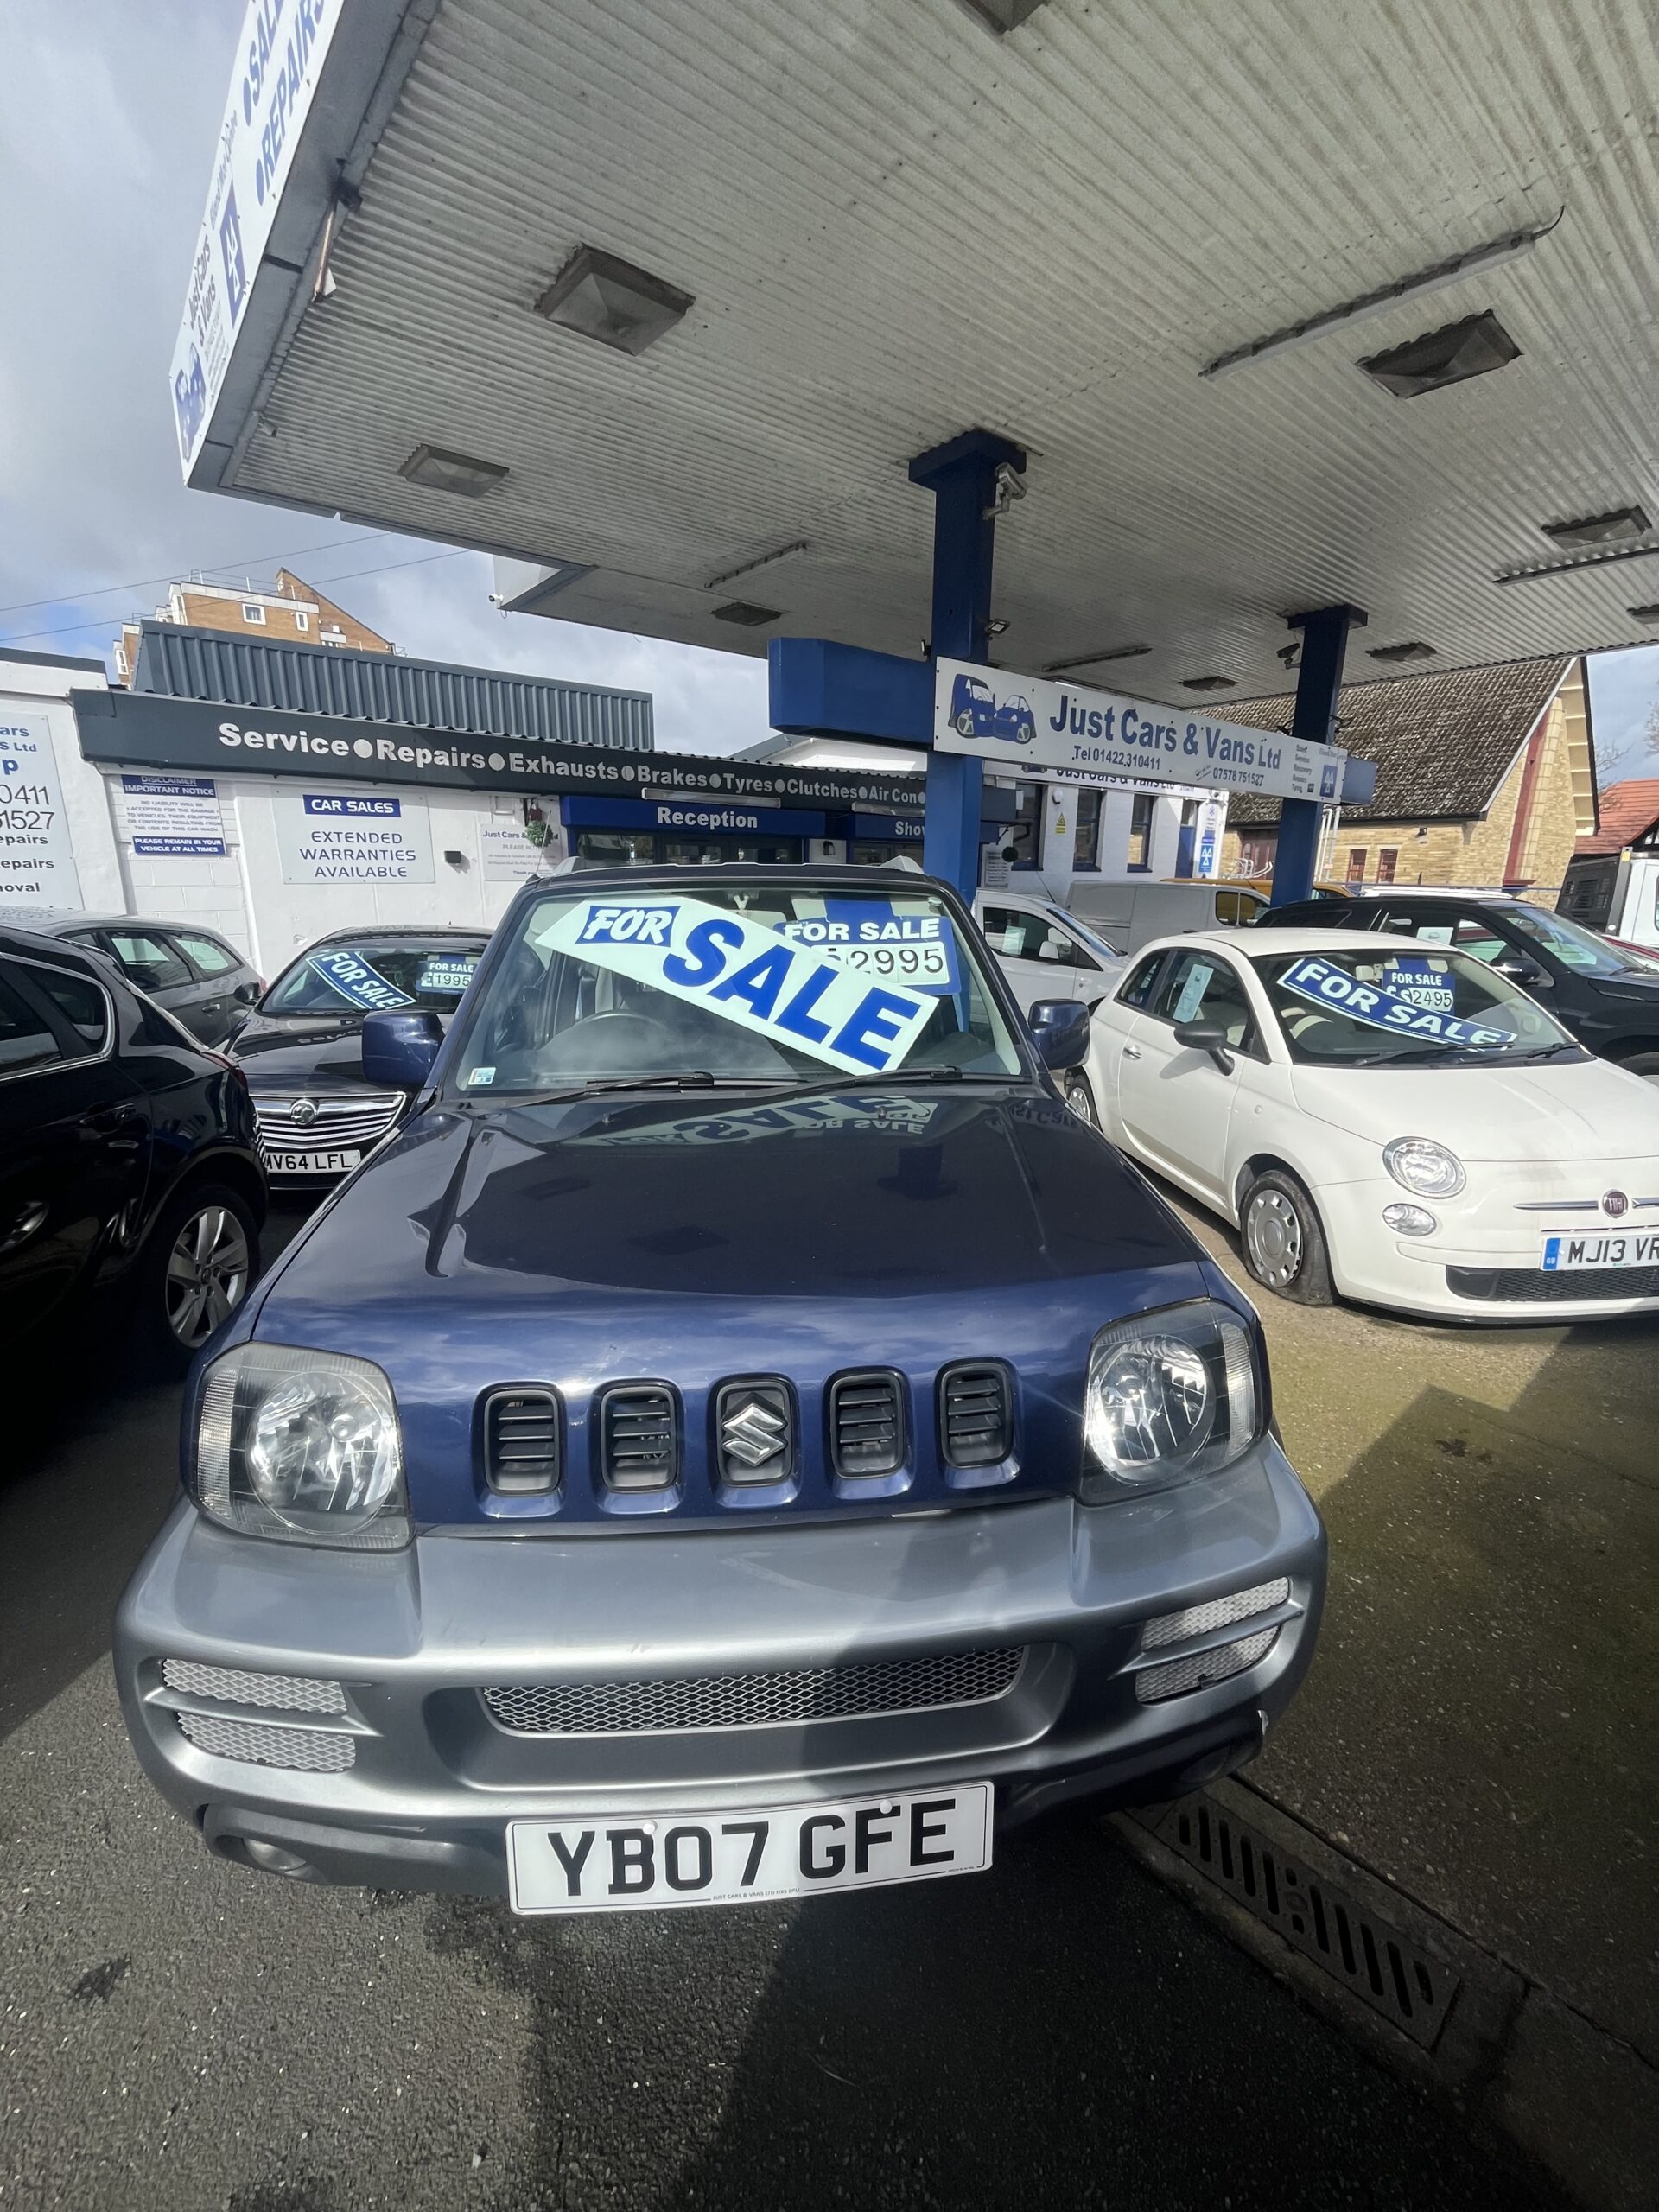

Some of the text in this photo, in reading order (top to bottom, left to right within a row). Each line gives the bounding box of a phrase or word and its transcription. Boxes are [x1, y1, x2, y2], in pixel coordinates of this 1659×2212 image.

[188, 233, 210, 331] Just Cars
[200, 274, 216, 332] Vans
[0, 727, 29, 736] ars
[1050, 695, 1281, 770] Just Cars & Vans Ltd
[13, 742, 37, 752] Ltd
[218, 722, 917, 804] Service Repairs Exhausts Brakes Tyres Clutches Air Con
[1074, 745, 1160, 771] Tel 01422 310411
[141, 776, 197, 785] DISCLAIMER
[1213, 766, 1237, 782] 07578
[1238, 771, 1264, 787] 751527
[0, 784, 50, 805] 0411
[124, 785, 180, 793] IMPORTANT
[311, 799, 394, 813] CAR SALES
[0, 810, 54, 830] 1527
[657, 806, 758, 830] Reception
[311, 831, 402, 843] EXTENDED
[0, 858, 54, 870] epairs
[299, 849, 416, 861] WARRANTIES
[315, 867, 407, 877] AVAILABLE
[583, 907, 673, 945] FOR
[785, 918, 939, 941] FOR SALE
[429, 963, 474, 973] FOR SALE
[321, 952, 404, 1008] FOR SALE
[1391, 972, 1442, 986] FOR SALE
[662, 918, 921, 1071] SALE
[1297, 963, 1503, 1046] FOR SALE
[1413, 989, 1452, 1007] 2495
[315, 1154, 353, 1169] LFL
[1567, 1237, 1659, 1263] MJ13 VR
[547, 1798, 956, 1897] YB07 GFE
